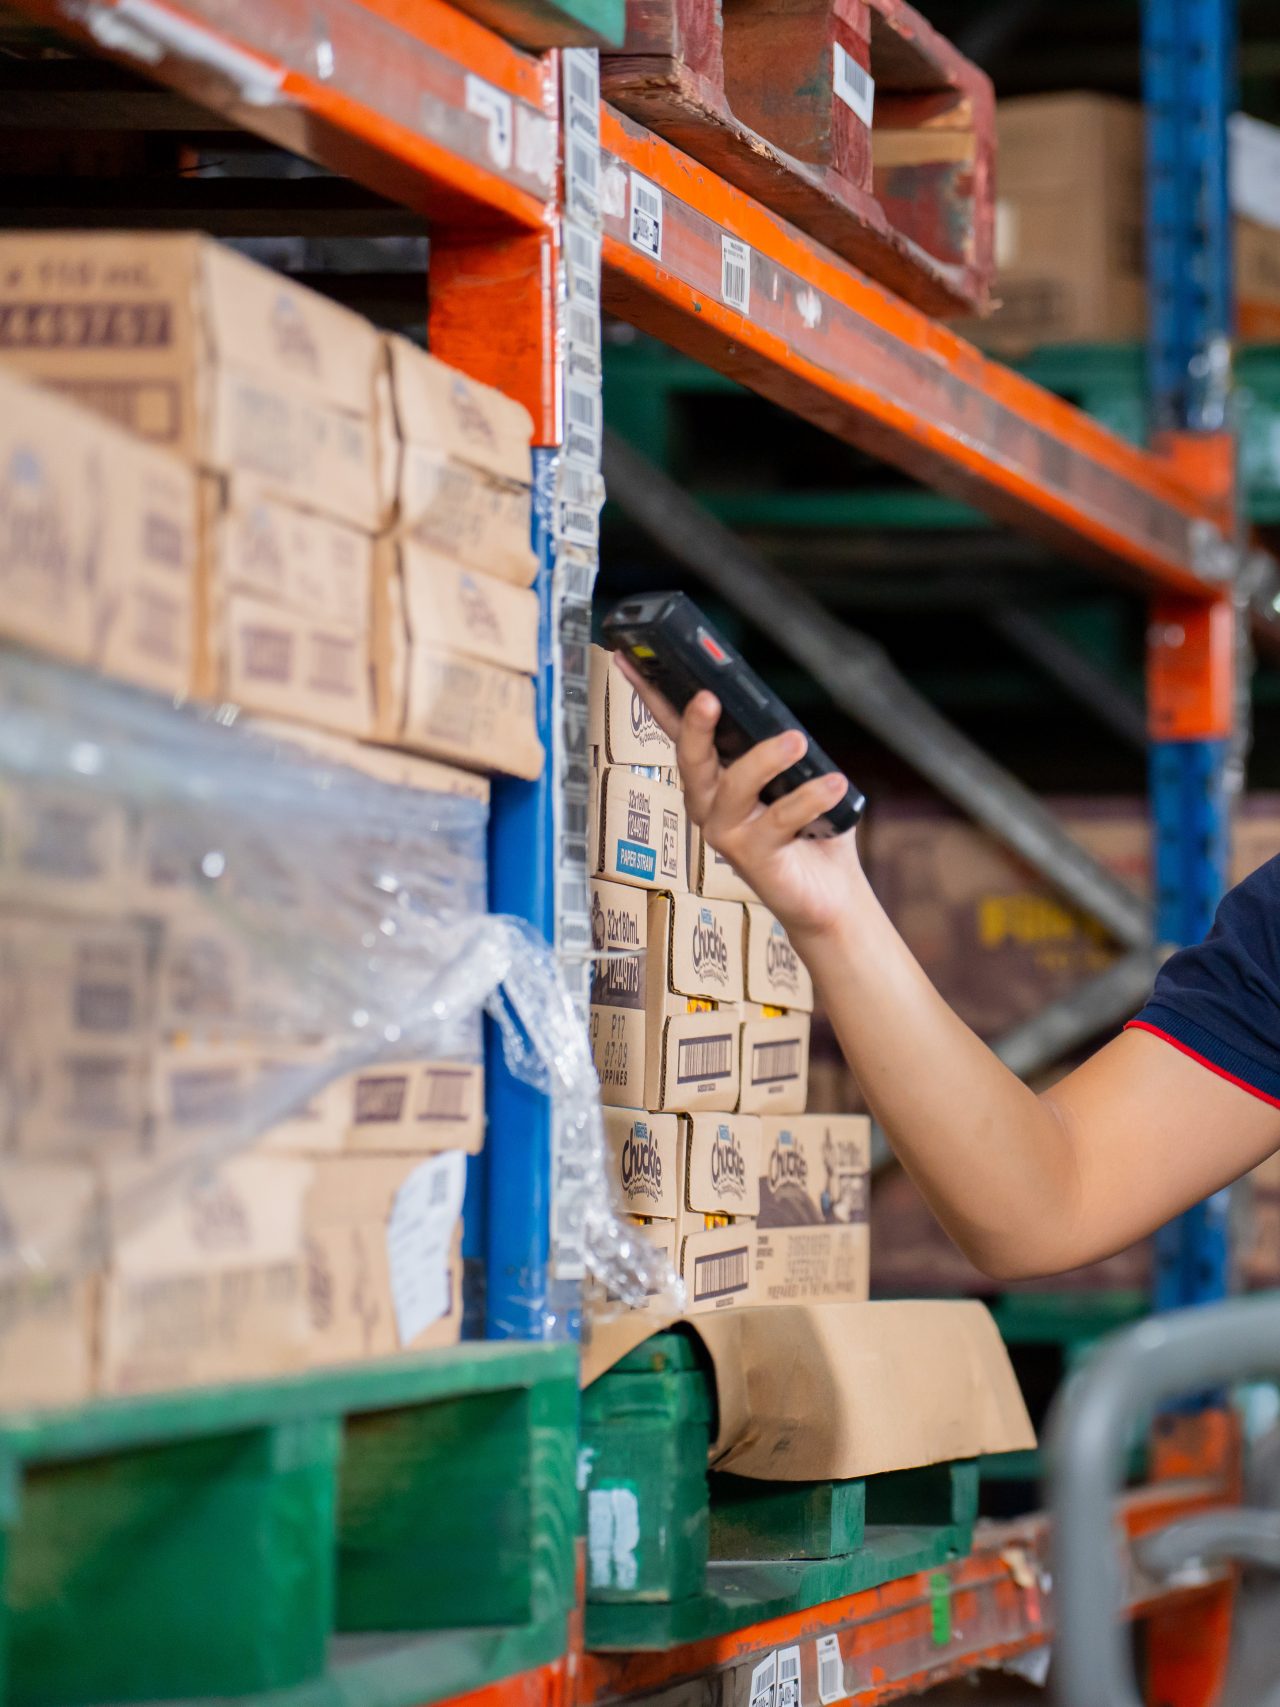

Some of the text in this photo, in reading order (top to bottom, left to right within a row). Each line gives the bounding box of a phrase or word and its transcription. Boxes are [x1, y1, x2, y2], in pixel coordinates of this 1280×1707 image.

[620, 848, 654, 873] PAPER STRAW
[607, 908, 640, 945] 32x180mL
[621, 1127, 662, 1188] Chuckie
